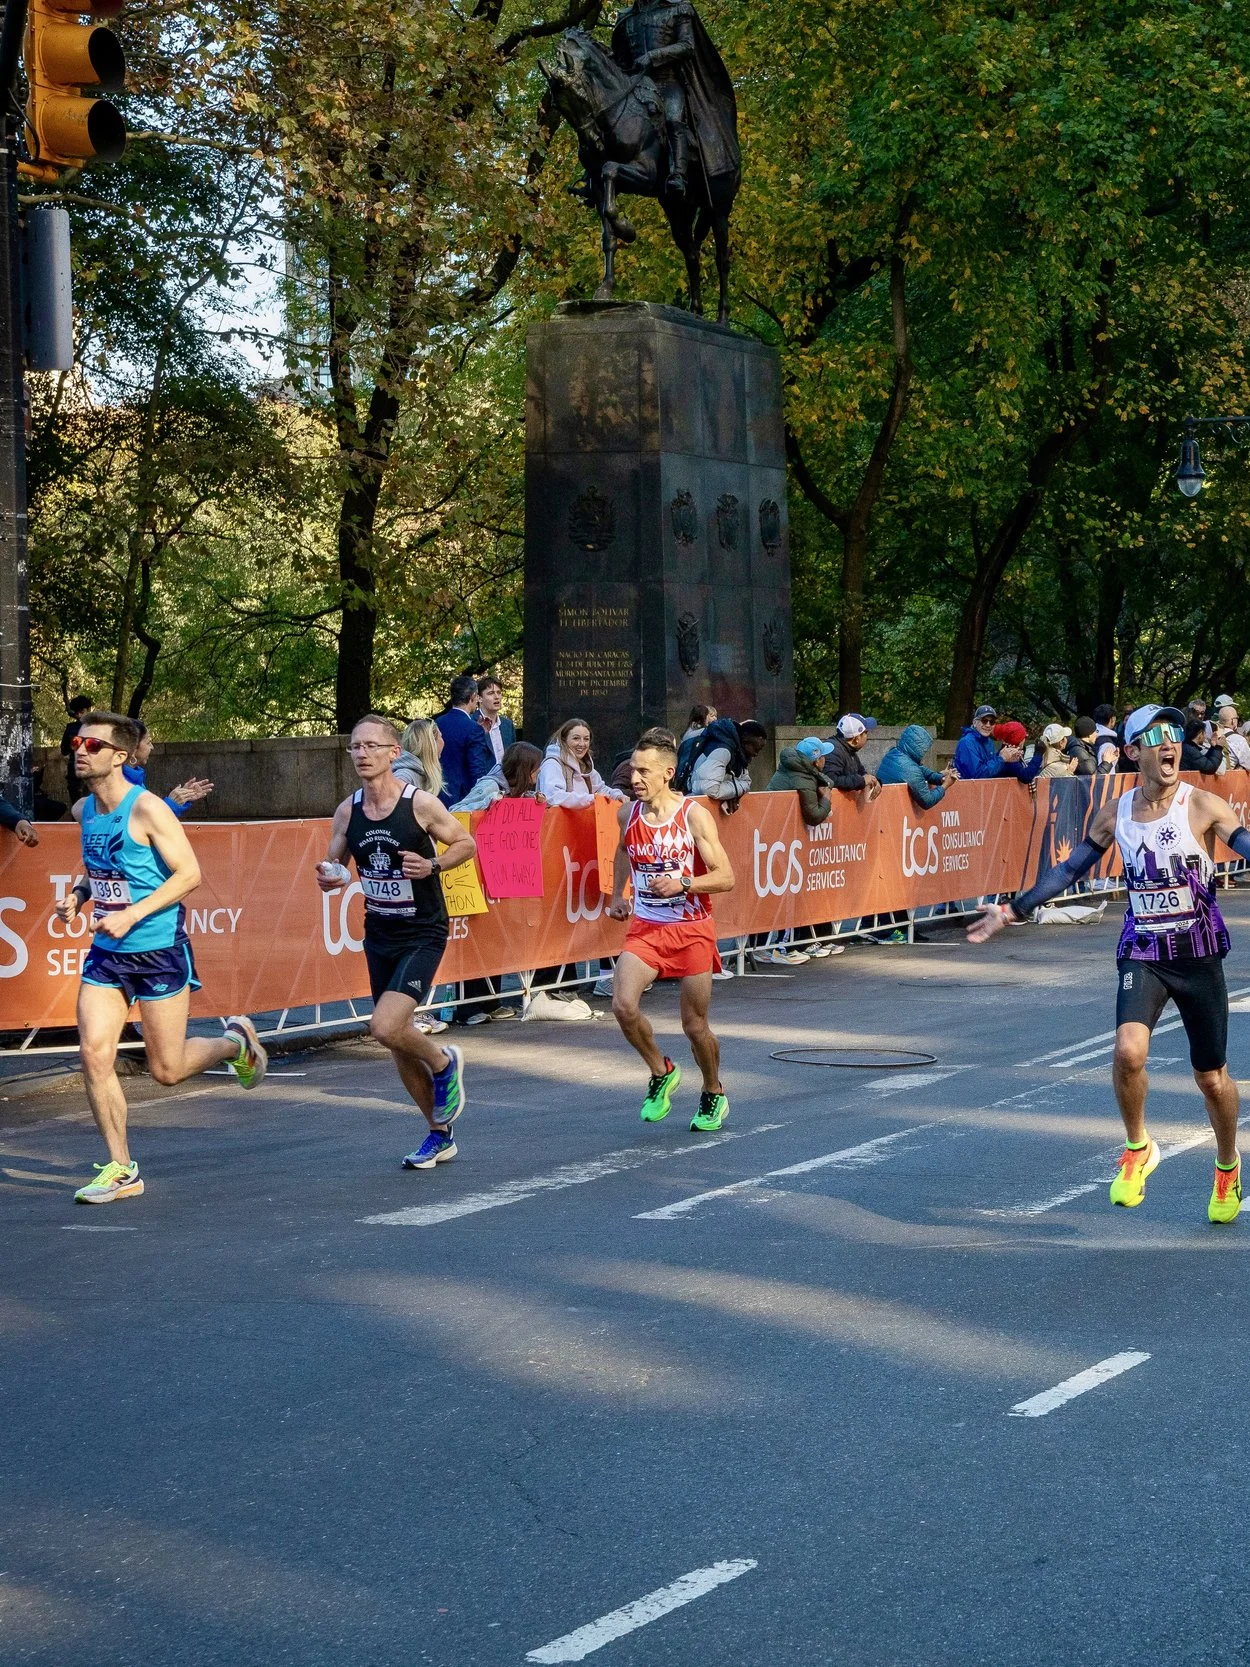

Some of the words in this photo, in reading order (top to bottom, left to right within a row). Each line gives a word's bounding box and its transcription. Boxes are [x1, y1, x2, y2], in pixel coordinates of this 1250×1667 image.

[559, 608, 588, 616] SIMON
[501, 803, 515, 824] DO
[518, 803, 536, 822] ALL
[941, 811, 960, 828] TATA
[358, 837, 375, 848] ROAD
[374, 836, 401, 847] RUNNERS
[365, 829, 392, 837] COLONIAL
[477, 833, 496, 853] THE
[500, 831, 519, 851] GOOD
[809, 823, 833, 842] TATA
[941, 830, 985, 851] CONSULTANCY
[637, 844, 687, 863] MONACO
[808, 843, 867, 867] CONSULTANCY
[902, 815, 939, 878] tcs
[753, 829, 804, 898] tcs
[942, 854, 969, 873] SERVICES
[94, 881, 122, 898] 1396
[368, 880, 401, 897] 1748
[806, 870, 846, 892] SERVICES
[1133, 880, 1146, 890] tcs
[1139, 891, 1180, 910] 1726
[322, 881, 365, 956] tc
